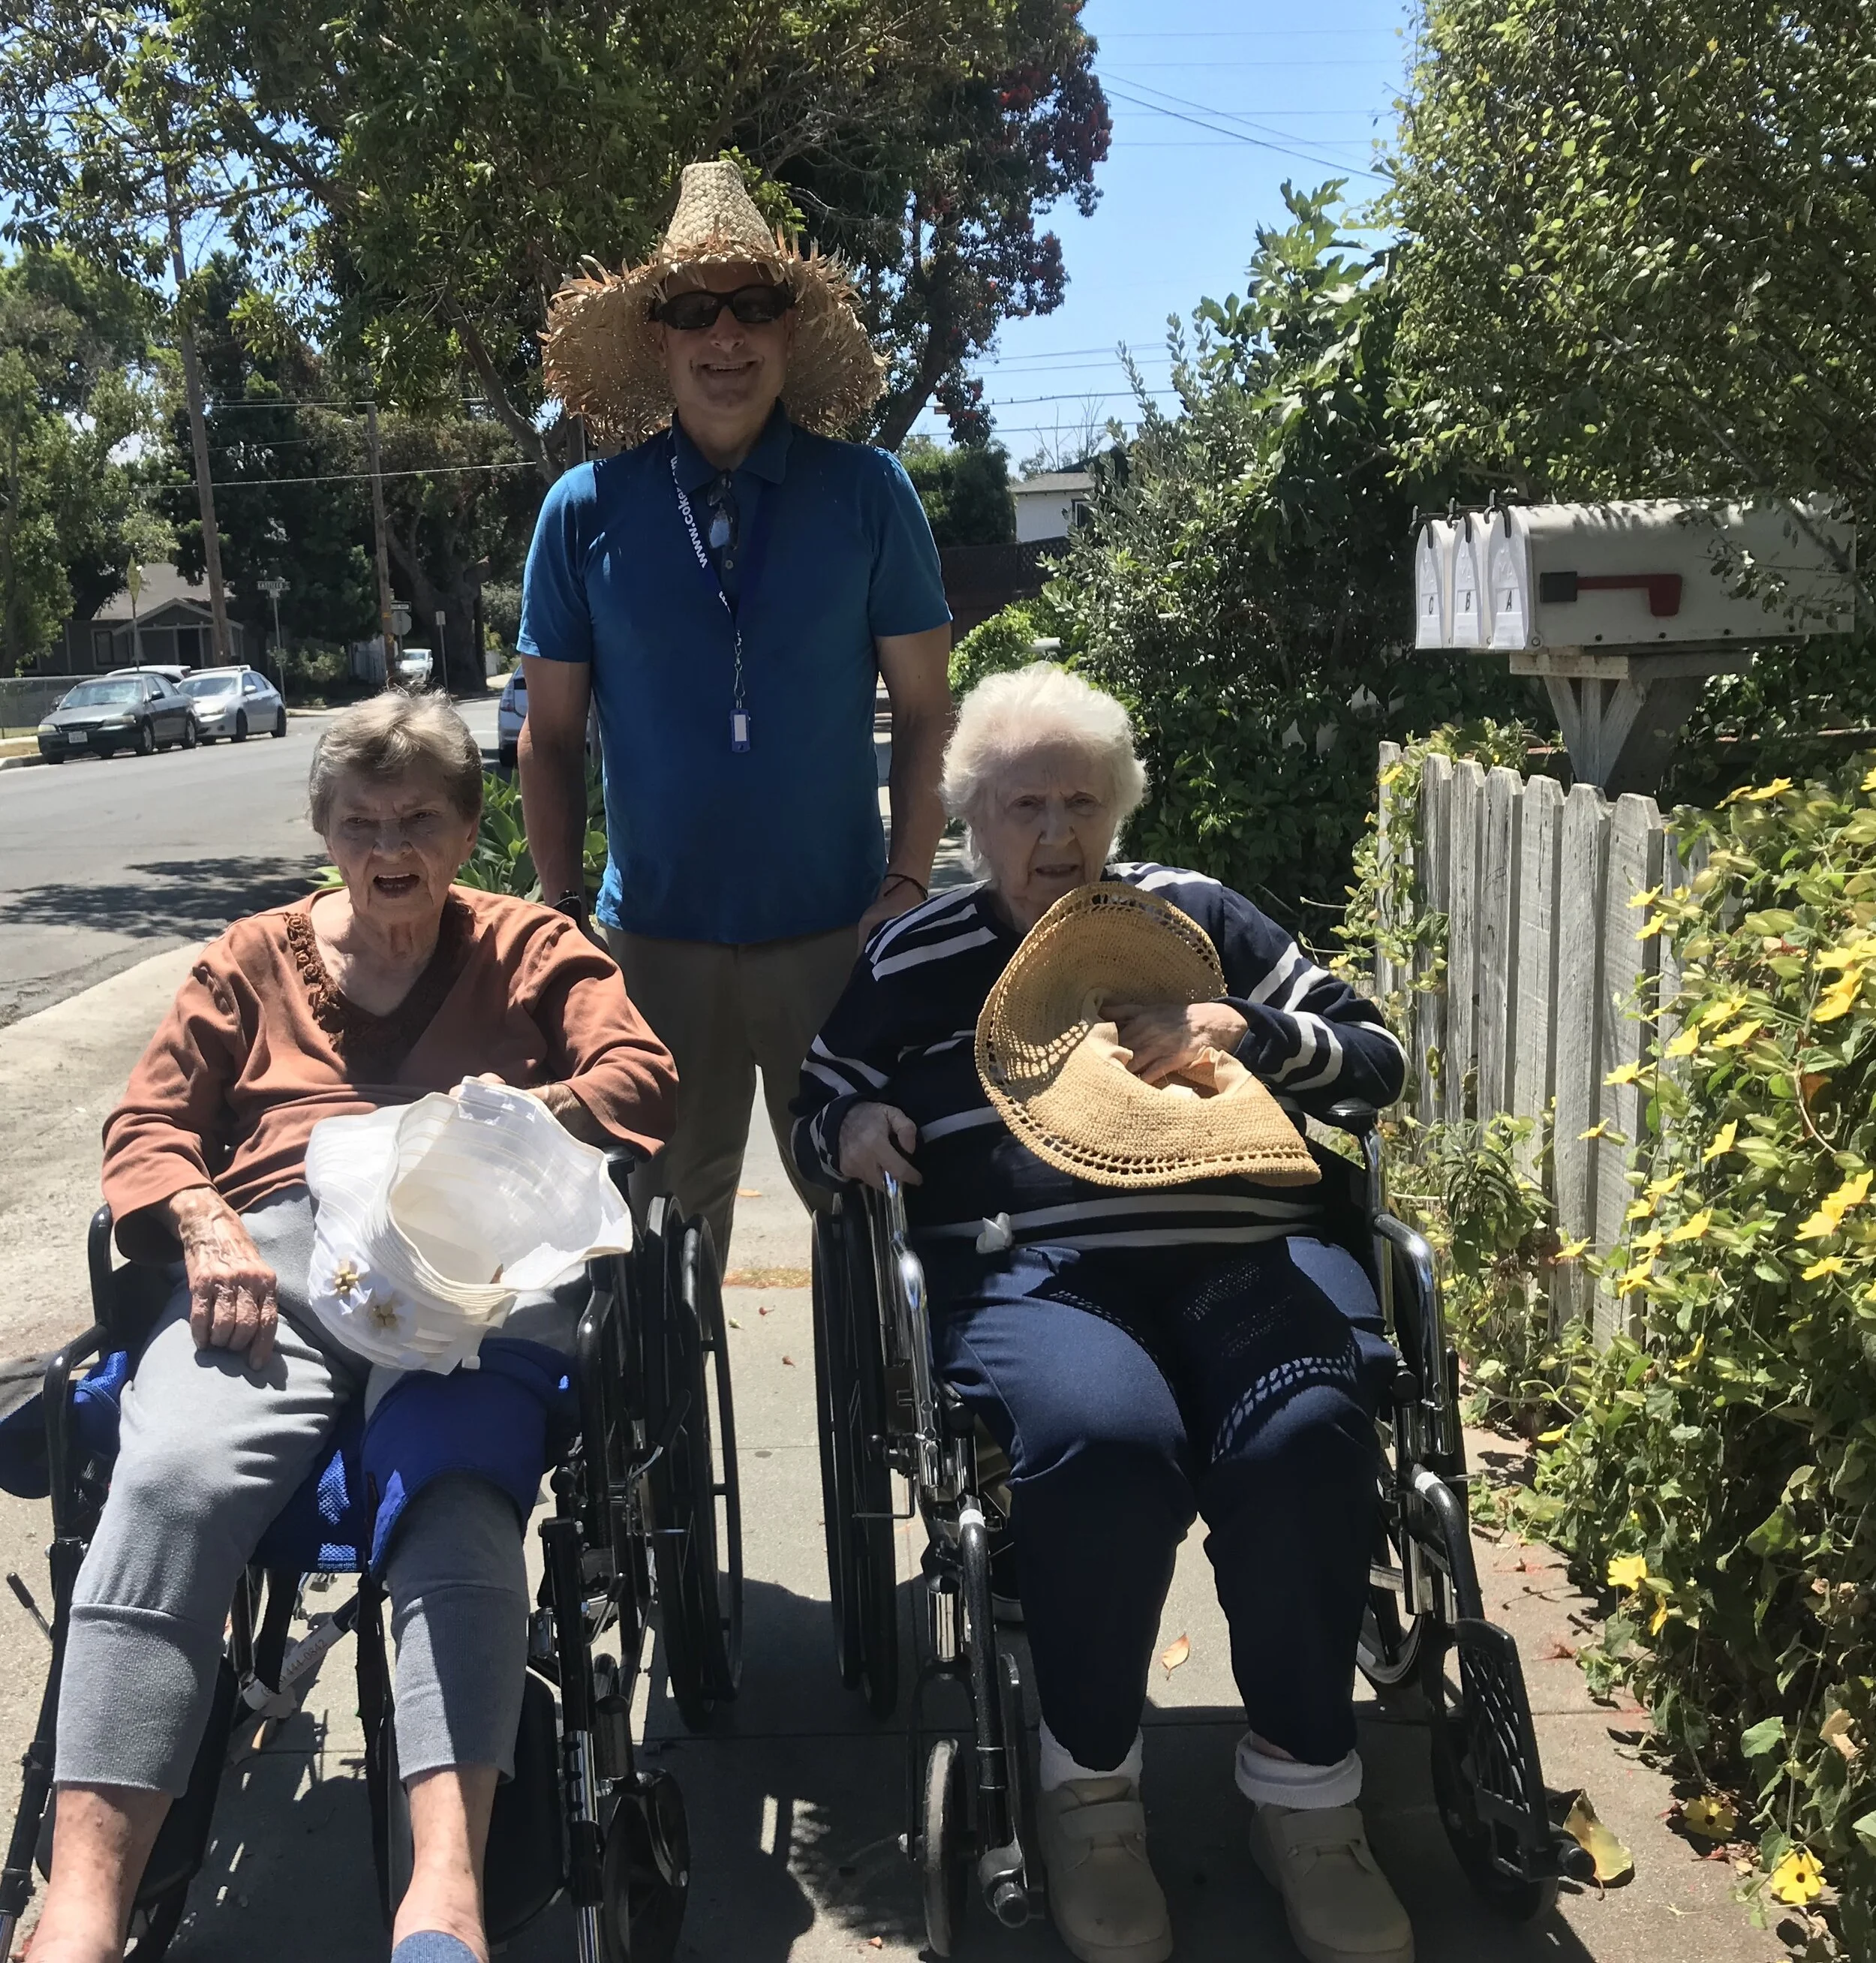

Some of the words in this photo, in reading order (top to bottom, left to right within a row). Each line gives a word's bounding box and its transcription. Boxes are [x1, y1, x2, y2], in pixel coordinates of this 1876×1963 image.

[1429, 596, 1434, 615] C
[1465, 591, 1471, 612] B
[1505, 590, 1512, 612] A
